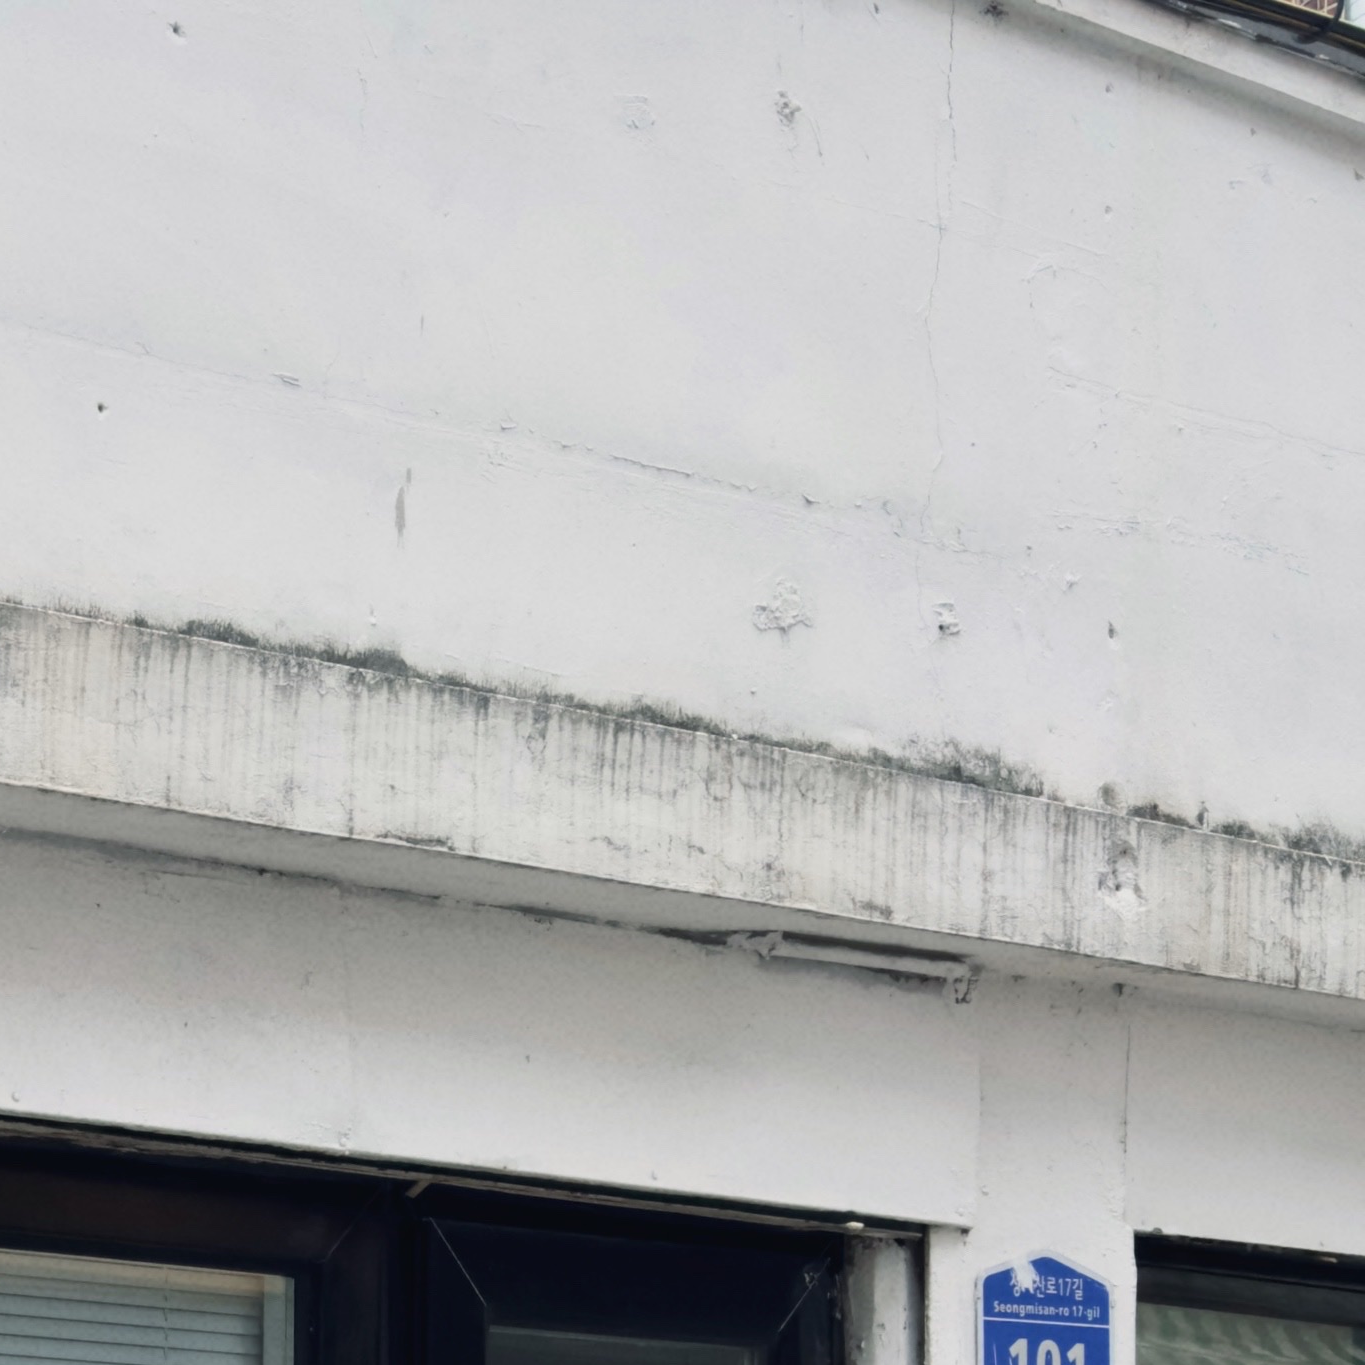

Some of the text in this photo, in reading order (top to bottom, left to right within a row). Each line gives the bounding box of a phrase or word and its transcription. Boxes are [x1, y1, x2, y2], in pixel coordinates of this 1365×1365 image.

[1009, 1274, 1084, 1300] 성산로17길
[993, 1301, 1101, 1321] Seongmisan-ro 17-gil
